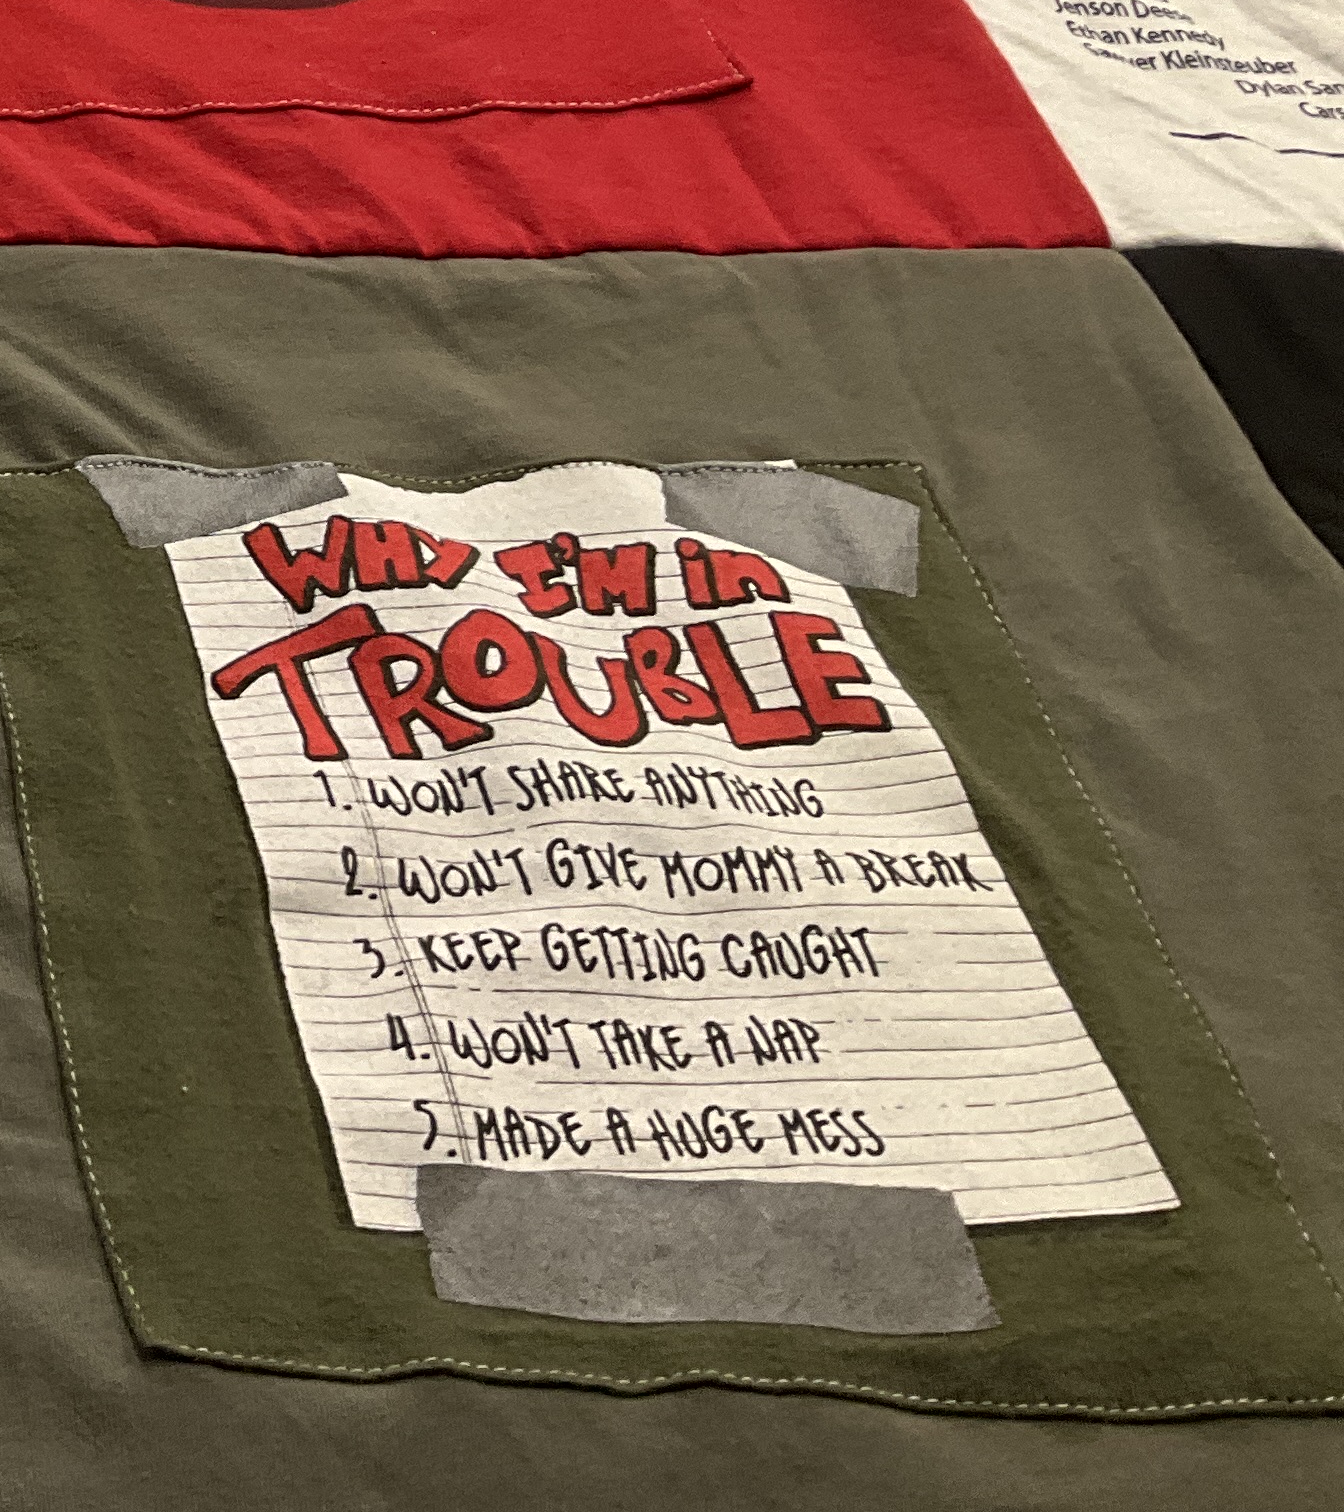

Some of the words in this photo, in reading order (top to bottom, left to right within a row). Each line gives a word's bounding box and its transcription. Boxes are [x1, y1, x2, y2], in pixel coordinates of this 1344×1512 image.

[1066, 19, 1131, 45] Ethan
[1131, 26, 1226, 52] Kennedy
[1160, 49, 1298, 76] Kleinsteuber
[1234, 78, 1305, 98] Dylan
[242, 515, 482, 613] WHY
[492, 534, 658, 617] I'M
[673, 536, 792, 610] in
[210, 603, 892, 762] TROUBLE
[312, 769, 354, 813] 1.
[368, 768, 496, 819] WON'T
[515, 761, 636, 810] SHARE
[643, 764, 826, 820] ANYTHING
[340, 845, 380, 901] 2.
[396, 847, 533, 905] WON'T
[545, 836, 649, 894] GIVE
[662, 846, 815, 899] MOMMY
[817, 848, 848, 887] A
[847, 847, 998, 893] BREAK
[358, 937, 406, 981] 3.
[418, 930, 522, 975] KEEP
[540, 922, 707, 984] GETTING
[721, 926, 881, 982] CAUGHT
[386, 1014, 431, 1063] 4.
[448, 1012, 582, 1072] WON'T
[587, 1017, 693, 1074] TAKE
[704, 1019, 733, 1065] A
[744, 1017, 821, 1072] NAP
[412, 1098, 459, 1159] 5.
[473, 1107, 593, 1161] MADE
[605, 1107, 636, 1154] A
[648, 1105, 767, 1164] HUGE
[779, 1107, 888, 1159] MESS
